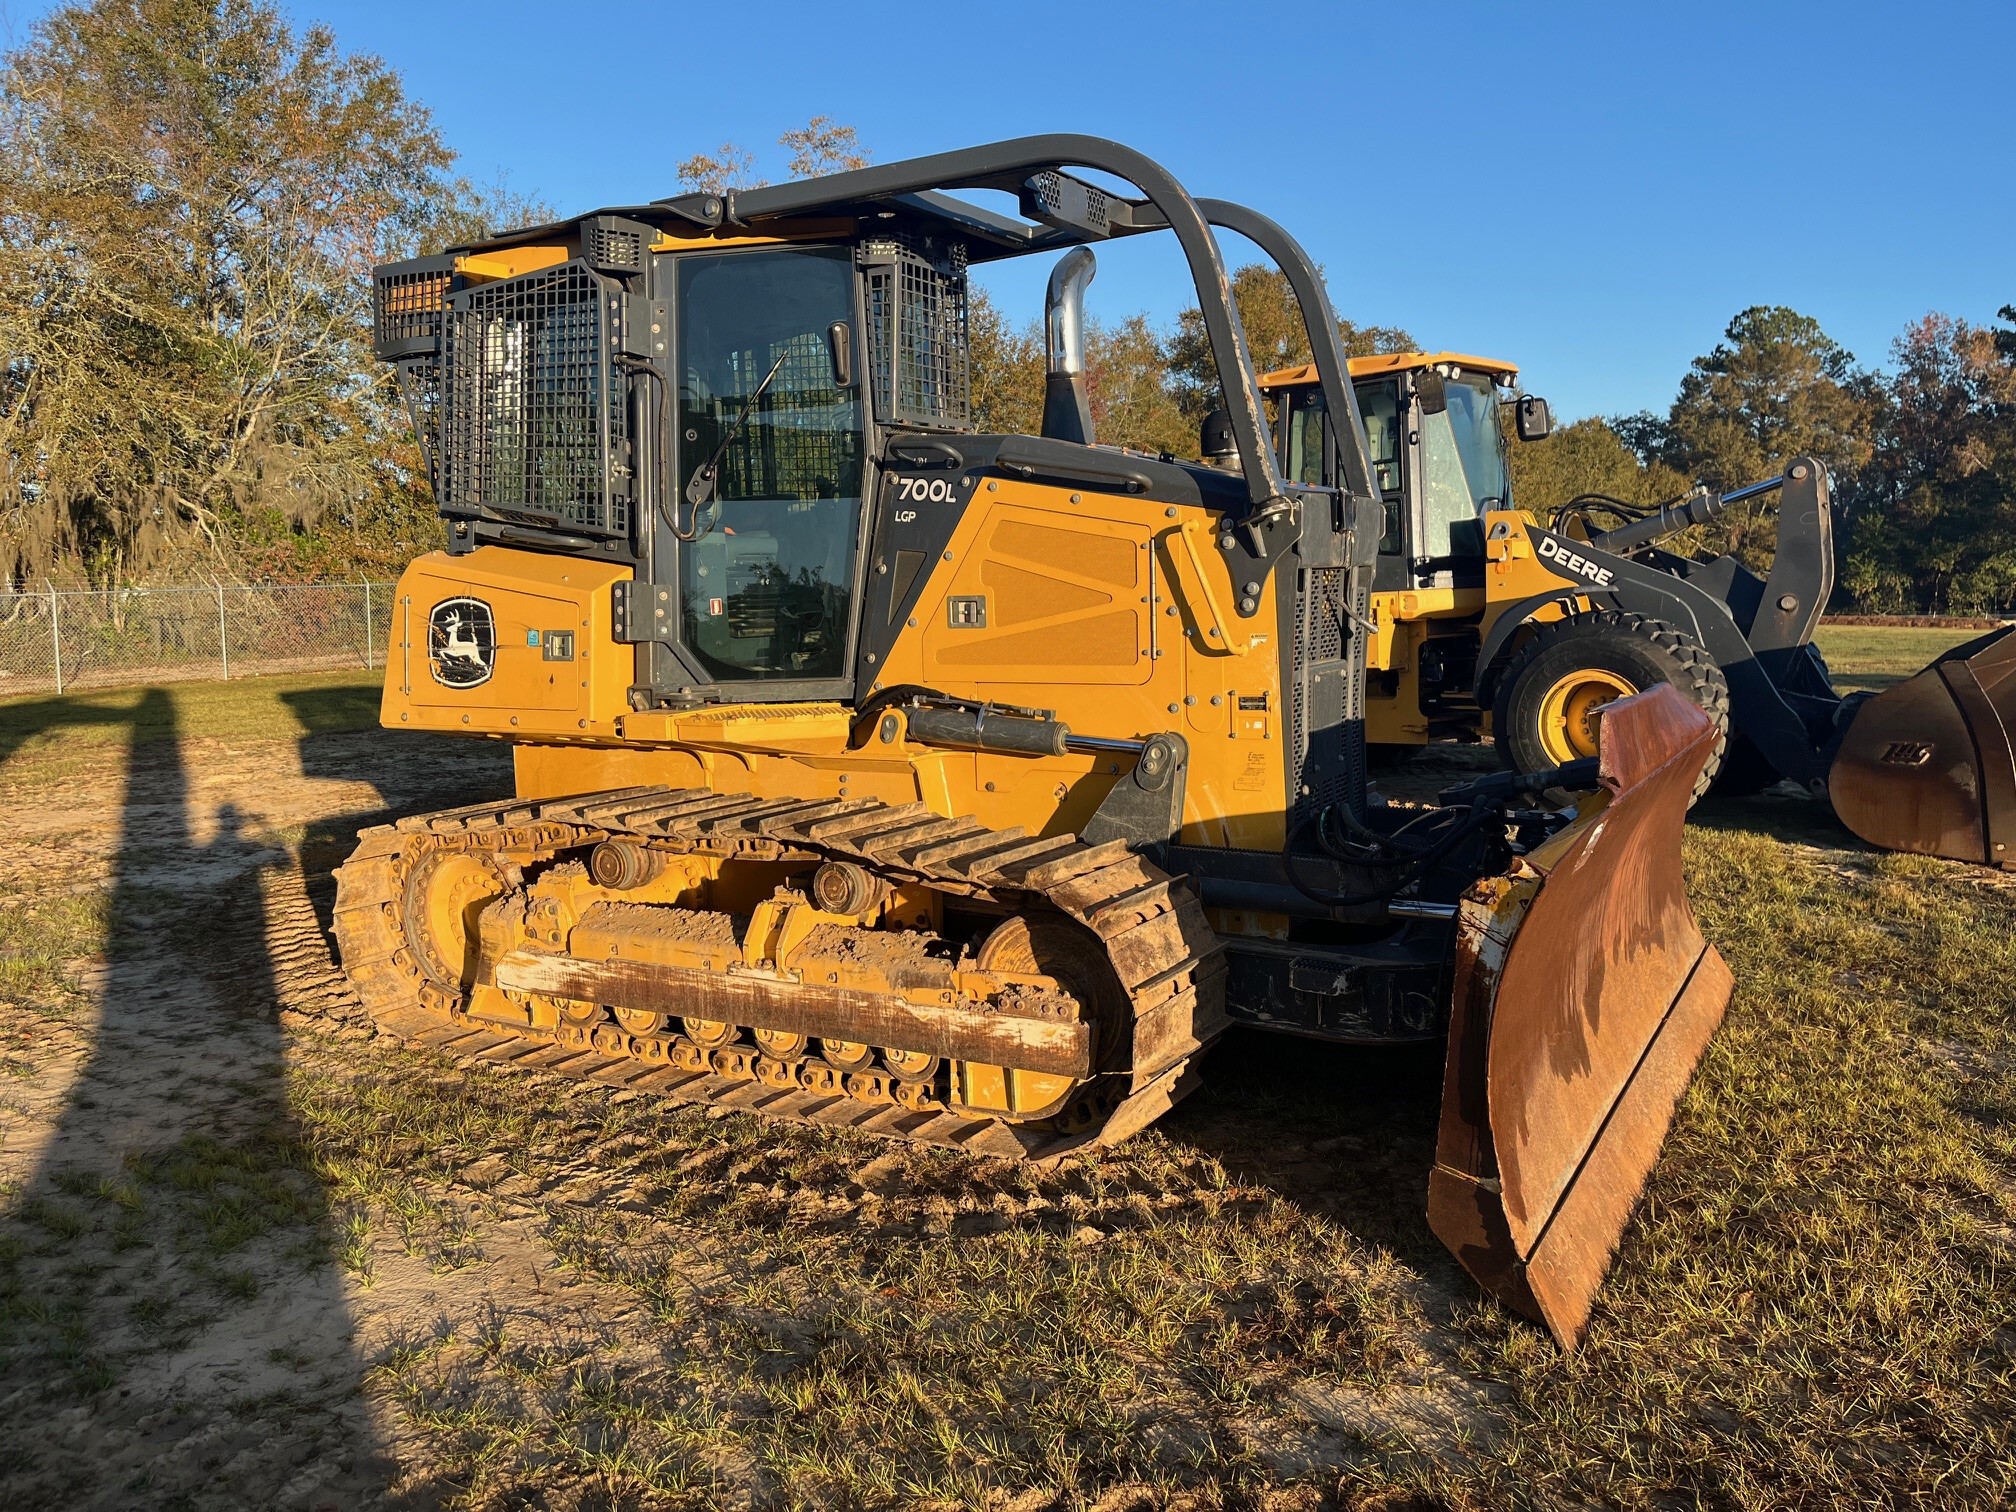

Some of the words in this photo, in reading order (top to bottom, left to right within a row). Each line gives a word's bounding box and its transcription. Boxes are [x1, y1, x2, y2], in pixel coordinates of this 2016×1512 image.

[899, 478, 957, 503] 700L
[894, 510, 917, 523] LGP
[1537, 535, 1614, 587] DEERE
